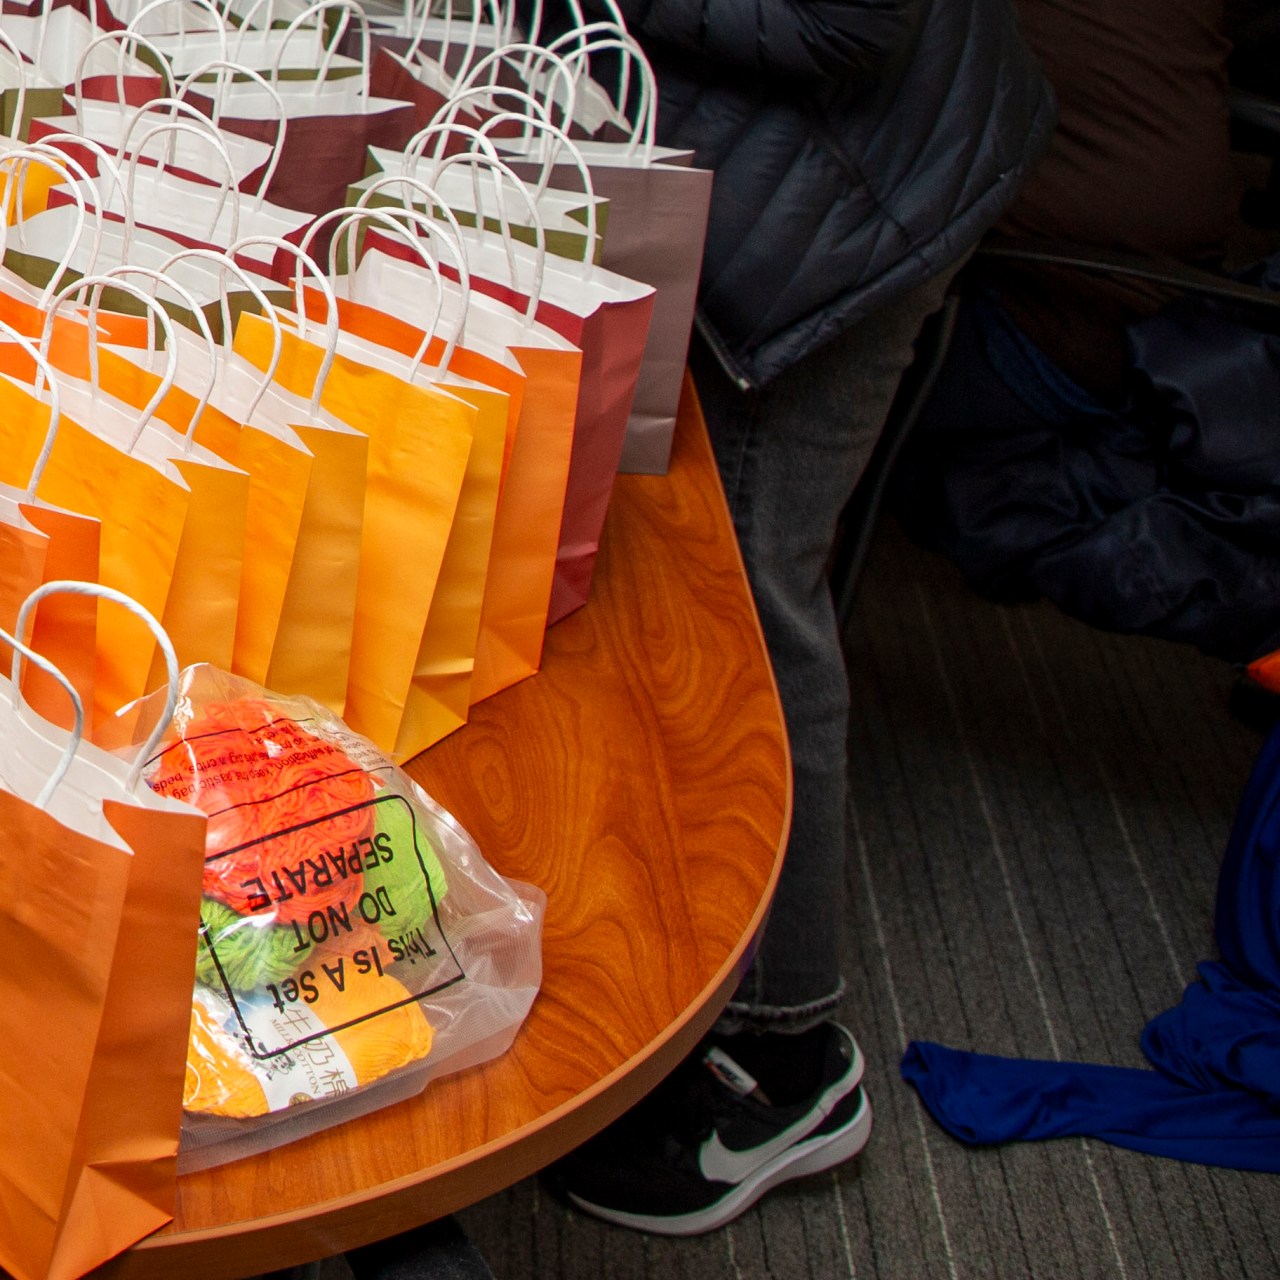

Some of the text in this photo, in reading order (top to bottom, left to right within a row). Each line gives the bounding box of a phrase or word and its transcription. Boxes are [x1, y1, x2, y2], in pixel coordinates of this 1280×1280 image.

[241, 832, 394, 912] SEPARATE
[291, 885, 397, 954] DO NOT
[353, 946, 384, 977] Is
[387, 927, 436, 965] This
[266, 970, 320, 1014] Set
[321, 957, 345, 992] A
[293, 1047, 320, 1095] COTTON
